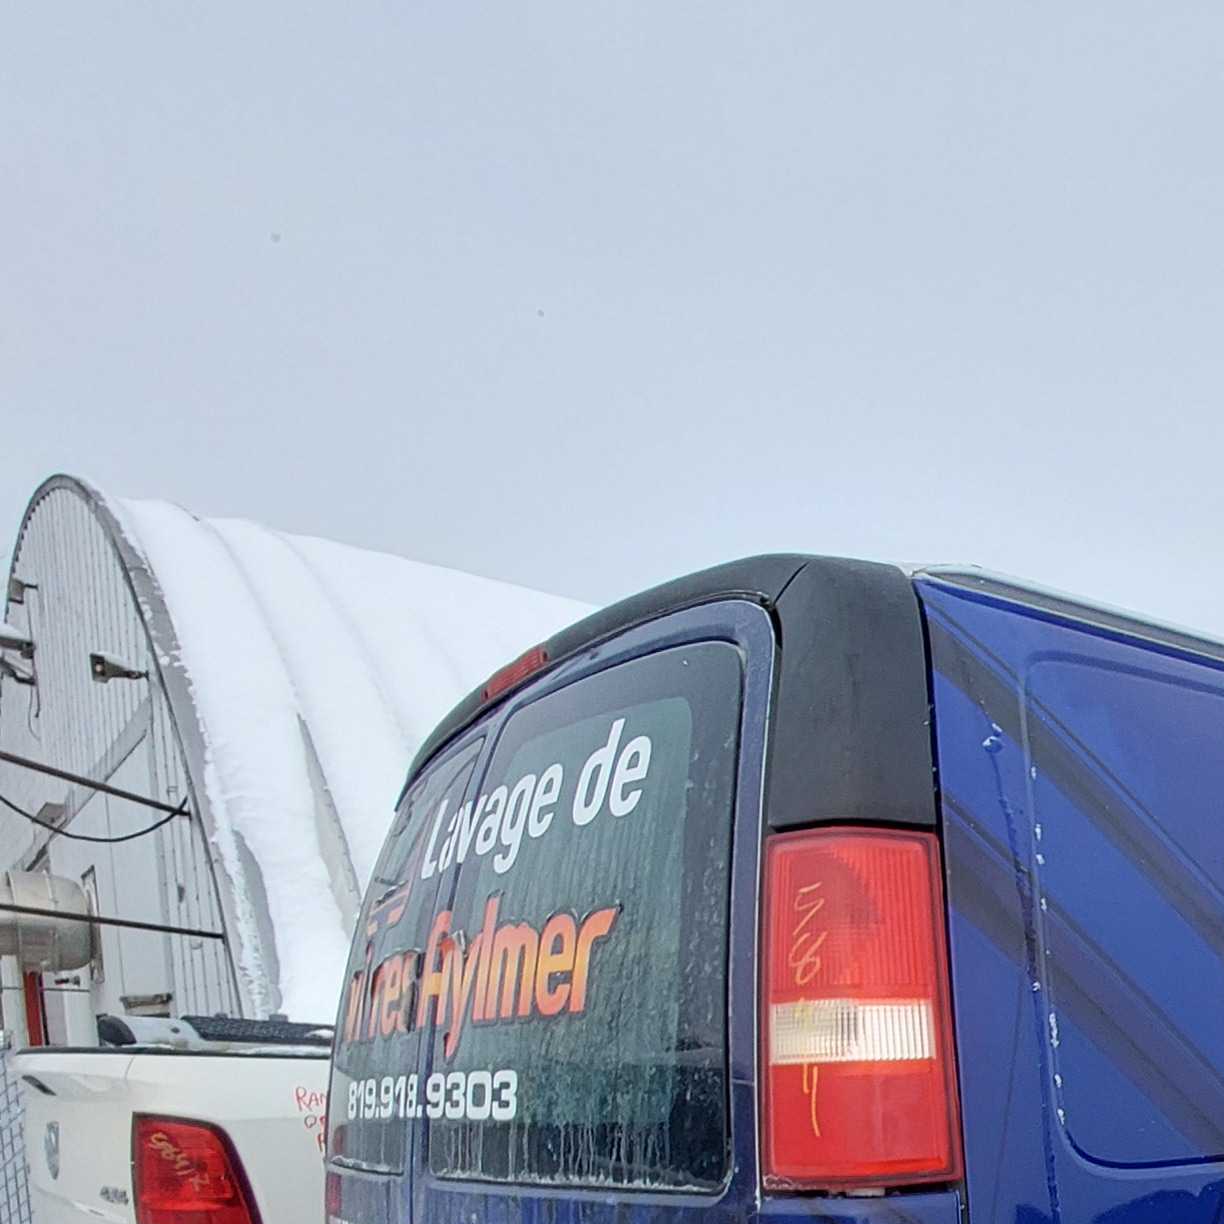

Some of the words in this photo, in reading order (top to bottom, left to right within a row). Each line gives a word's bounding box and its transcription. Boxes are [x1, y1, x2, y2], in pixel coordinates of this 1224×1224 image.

[420, 762, 563, 881] Lavage
[571, 717, 653, 827] de
[416, 890, 624, 1060] Aylmer
